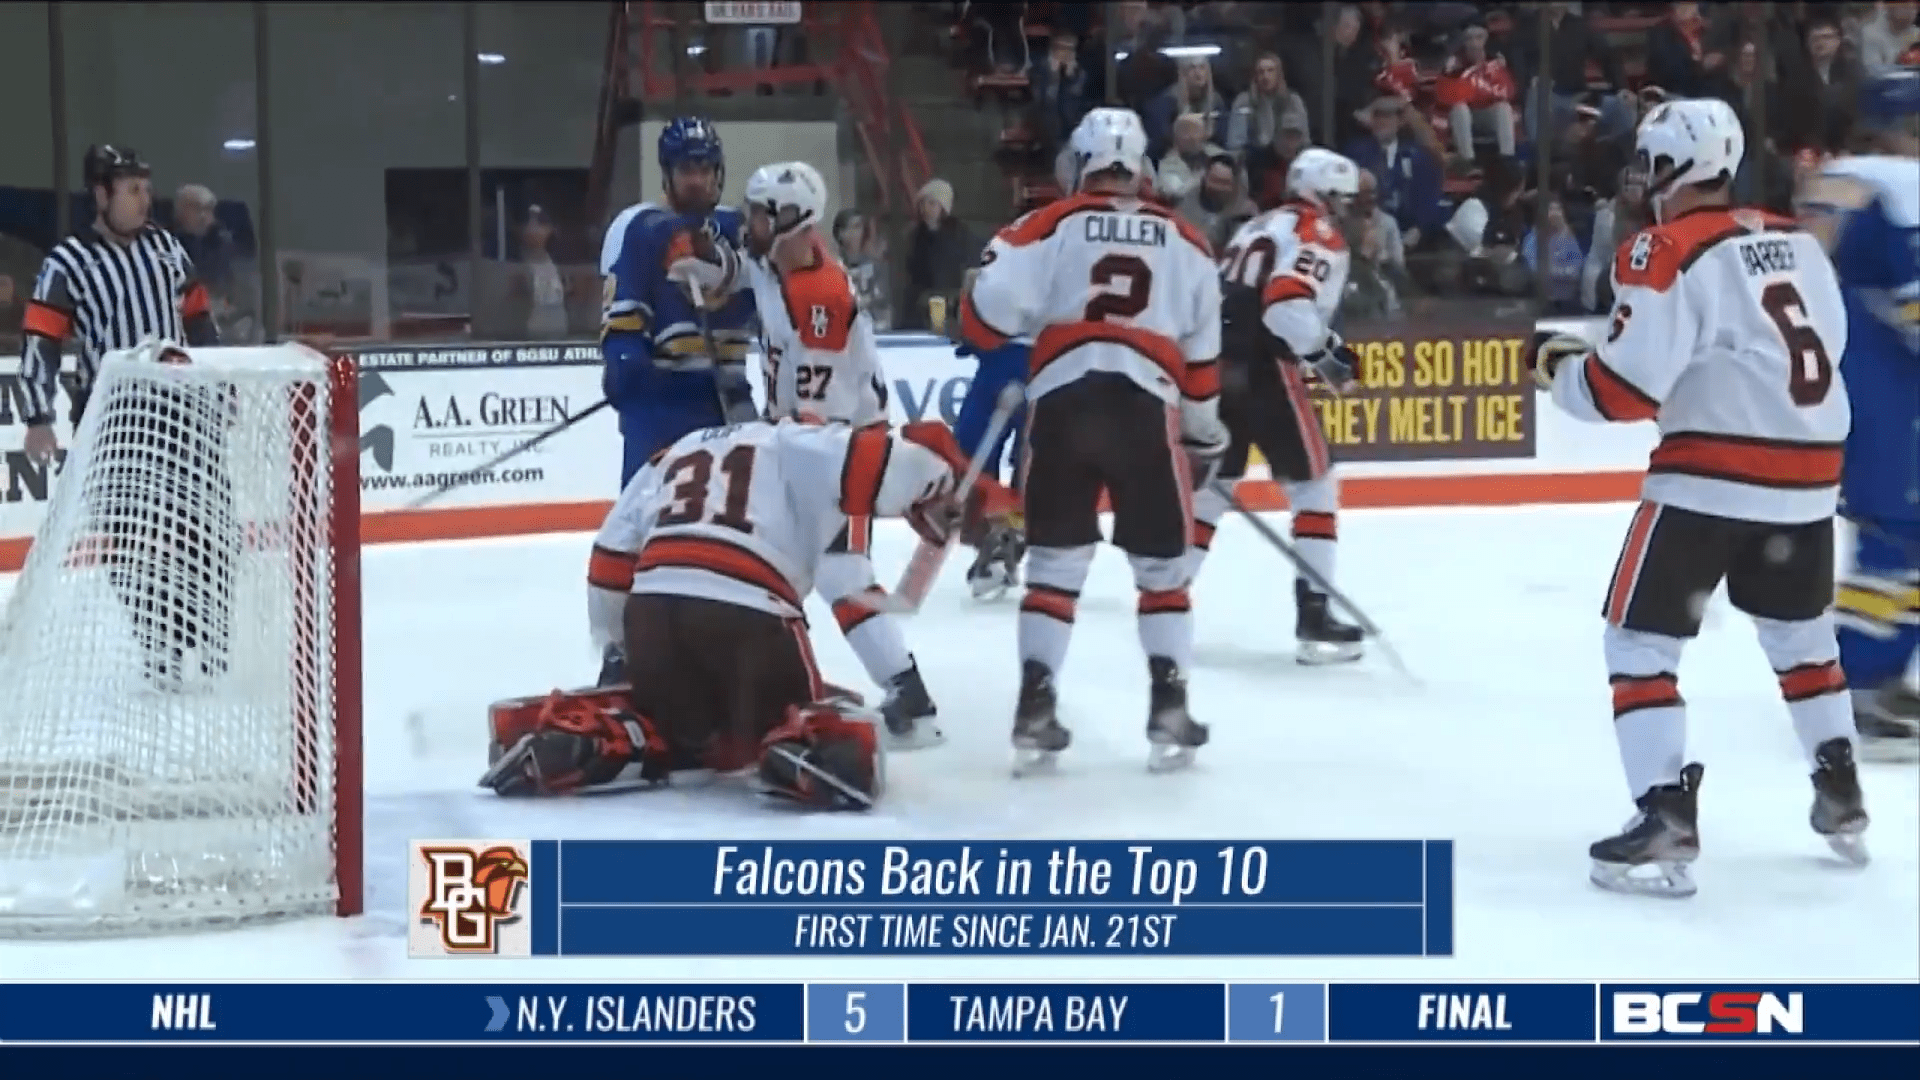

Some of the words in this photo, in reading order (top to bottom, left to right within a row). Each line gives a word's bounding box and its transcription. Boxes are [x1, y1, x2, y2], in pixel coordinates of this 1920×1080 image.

[1085, 215, 1166, 248] CULLEN
[1294, 249, 1331, 282] 20
[1085, 253, 1153, 323] 2
[359, 353, 414, 367] ESTATE
[418, 351, 487, 366] PARTNER
[491, 350, 514, 363] OF
[1413, 340, 1454, 387] SO
[1462, 338, 1525, 387] HOT
[1761, 281, 1833, 409] 6
[796, 364, 833, 400] 27
[413, 395, 472, 429] A.A.
[1388, 395, 1469, 443] MELT
[1476, 394, 1525, 442] ICE
[656, 443, 757, 534] 31
